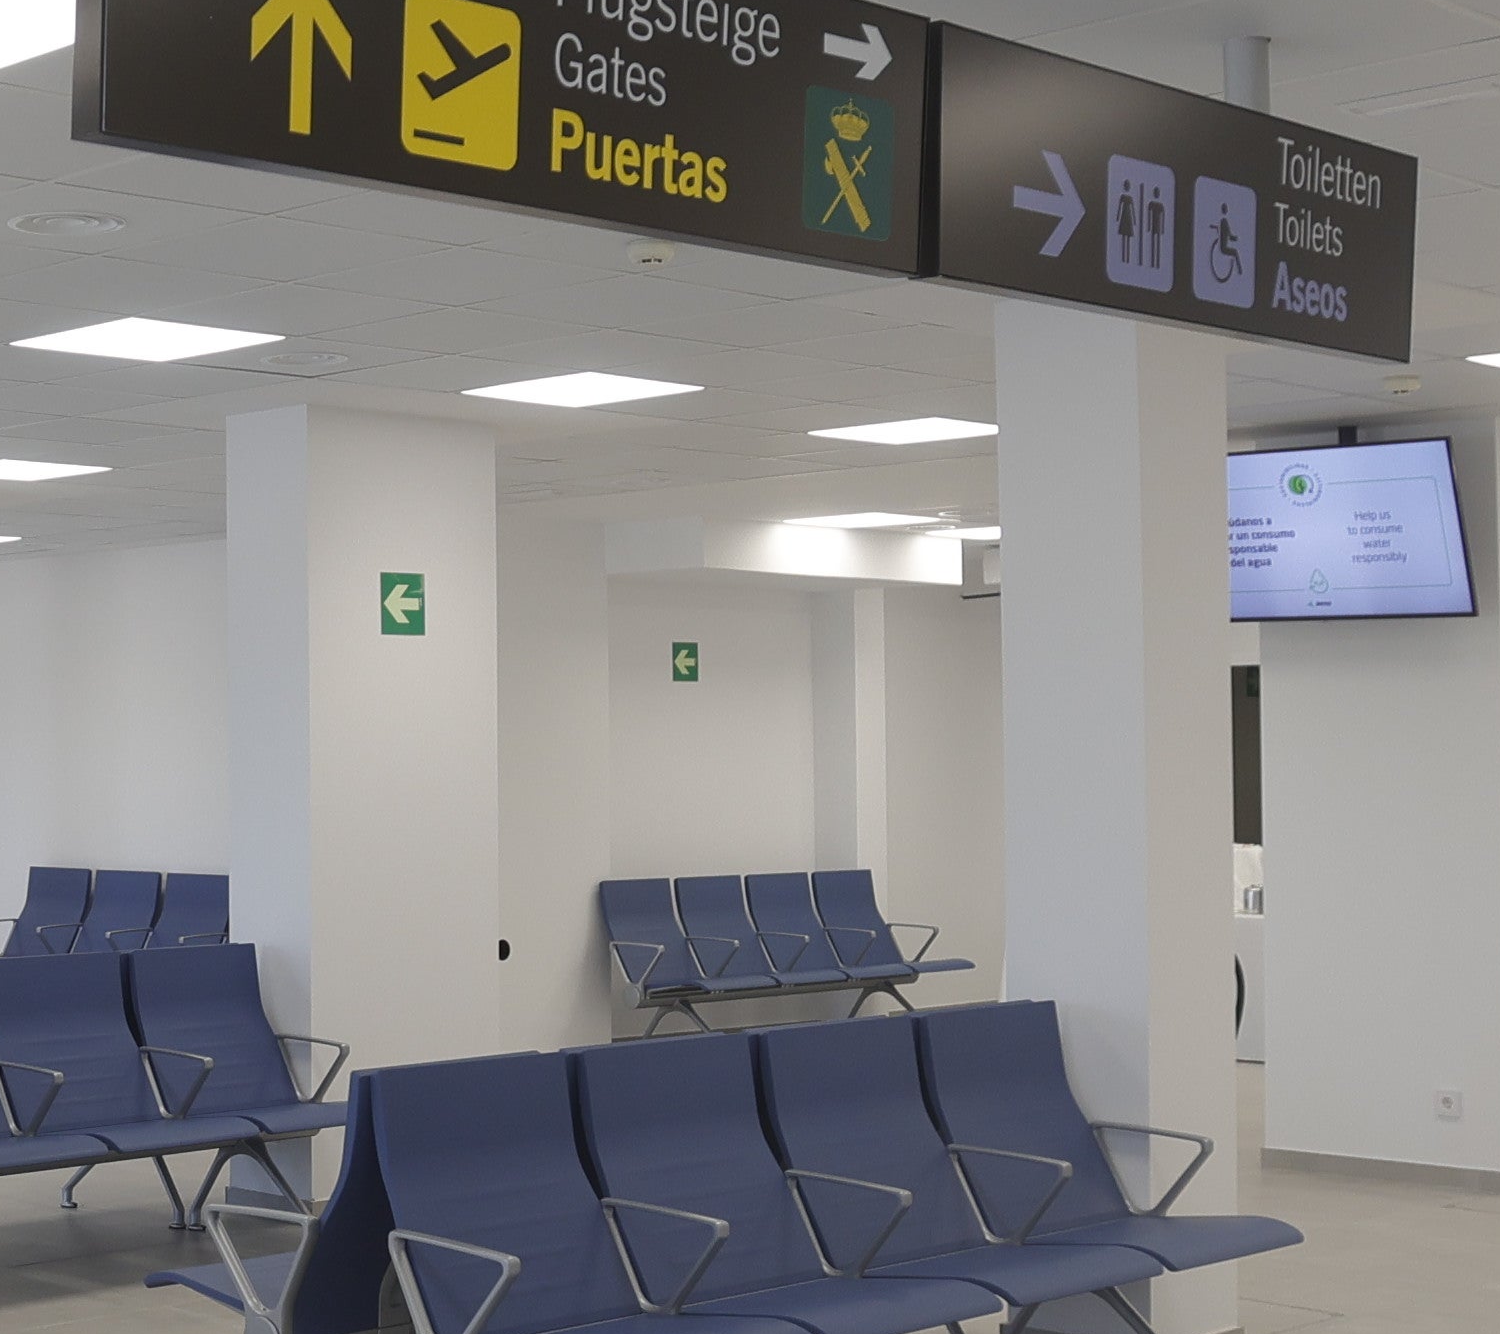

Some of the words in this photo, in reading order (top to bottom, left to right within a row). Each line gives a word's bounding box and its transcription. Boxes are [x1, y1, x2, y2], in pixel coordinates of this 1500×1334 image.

[553, 32, 667, 107] Gates
[550, 107, 729, 203] Puertas
[1276, 135, 1382, 209] Toiletten
[1273, 201, 1344, 257] Toilets
[1271, 260, 1348, 322] Aseos
[1228, 517, 1264, 527] údanos
[1353, 511, 1377, 521] Help
[1379, 512, 1391, 520] us
[1236, 532, 1249, 540] un
[1251, 530, 1296, 540] consumo
[1347, 526, 1358, 535] to
[1360, 524, 1403, 535] consume
[1228, 543, 1278, 556] sponsable
[1363, 539, 1391, 548] water
[1230, 558, 1245, 567] del
[1247, 558, 1272, 568] agua
[1351, 551, 1408, 564] responsibly
